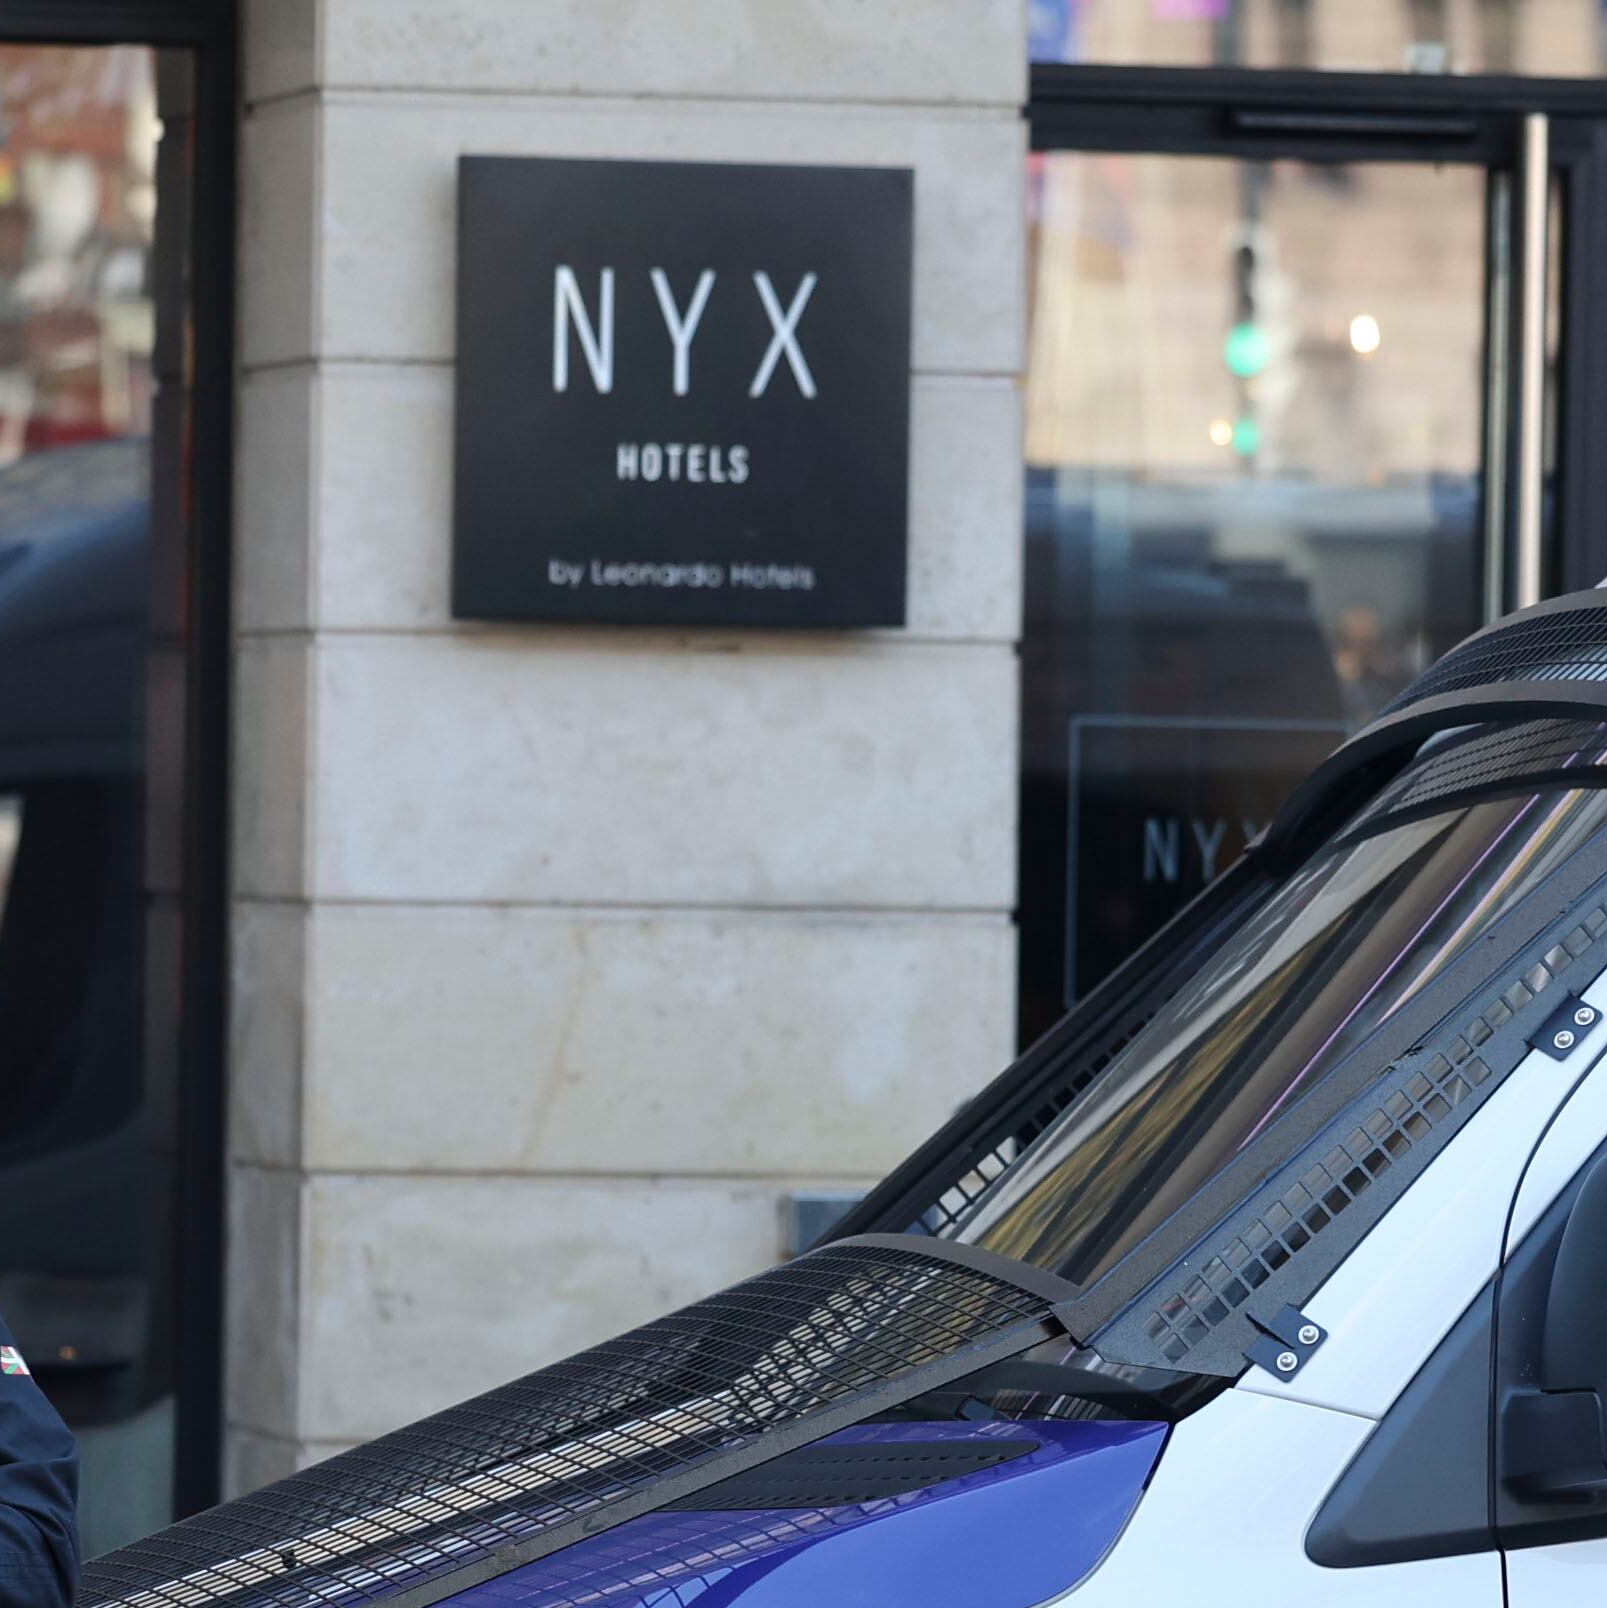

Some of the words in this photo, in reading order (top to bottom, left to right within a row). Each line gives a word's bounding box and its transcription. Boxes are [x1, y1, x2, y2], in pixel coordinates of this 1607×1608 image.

[552, 263, 819, 400] NYX
[616, 441, 751, 484] HOTELS
[547, 557, 587, 590] by
[590, 557, 728, 588] Leonardo
[729, 560, 818, 592] Hotels
